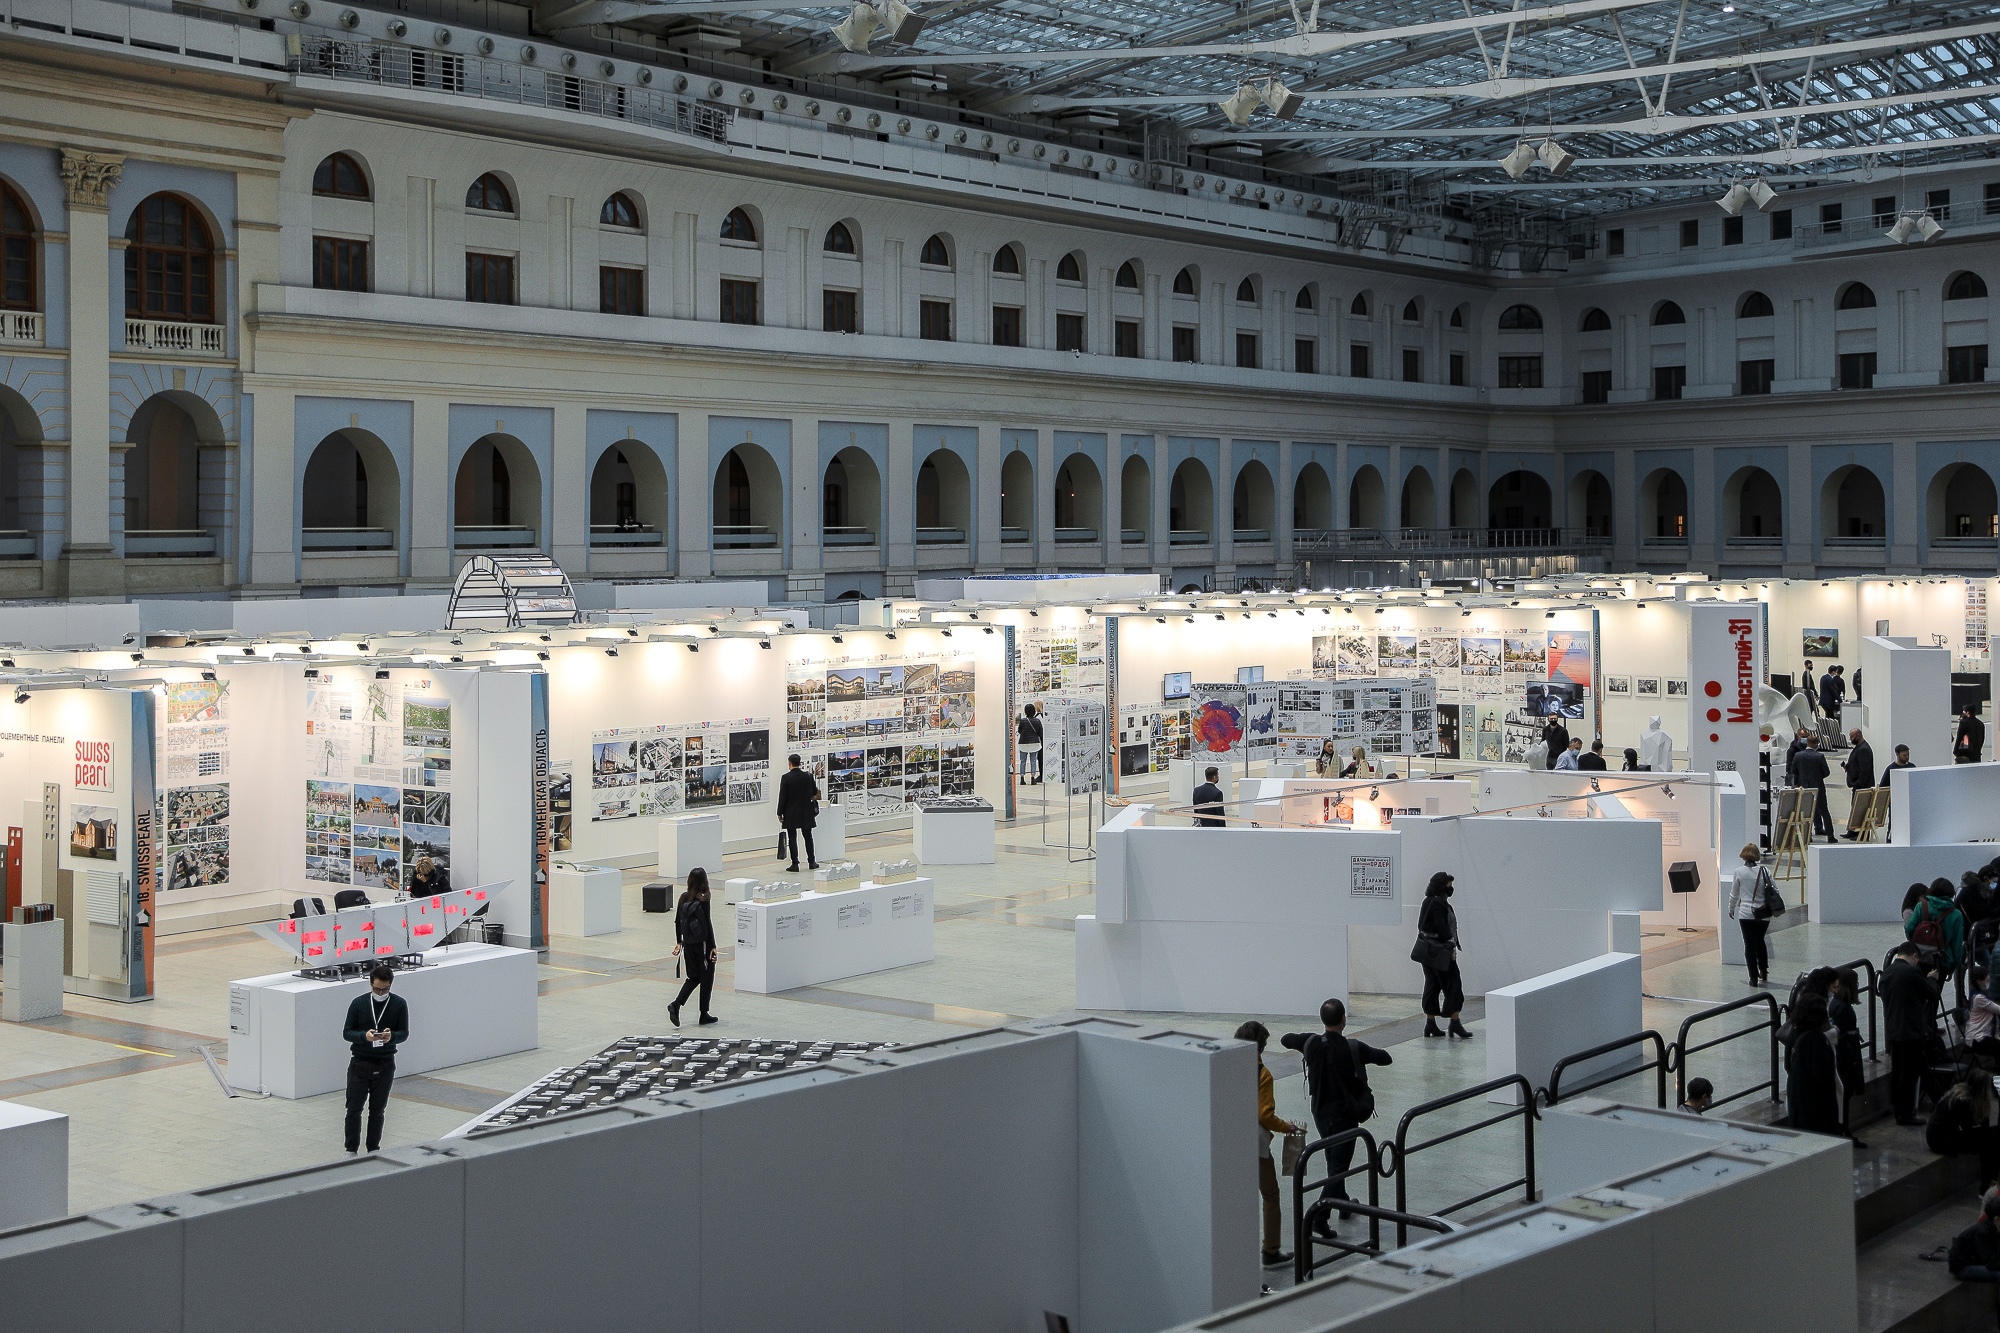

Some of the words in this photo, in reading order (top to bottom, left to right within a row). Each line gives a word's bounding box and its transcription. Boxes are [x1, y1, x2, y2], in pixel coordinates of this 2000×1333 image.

[1727, 619, 1753, 722] Мосстрой-31
[0, 732, 39, 742] ОЦЕМЕНТНЫЕ
[42, 735, 65, 744] ПАНЕЛИ
[536, 729, 546, 777] ОБЛАСТЬ
[536, 780, 547, 848] ТЮМЕНСКАЯ
[137, 810, 151, 885] SWISSPEARL
[536, 850, 547, 864] 19.
[137, 888, 150, 904] 18.
